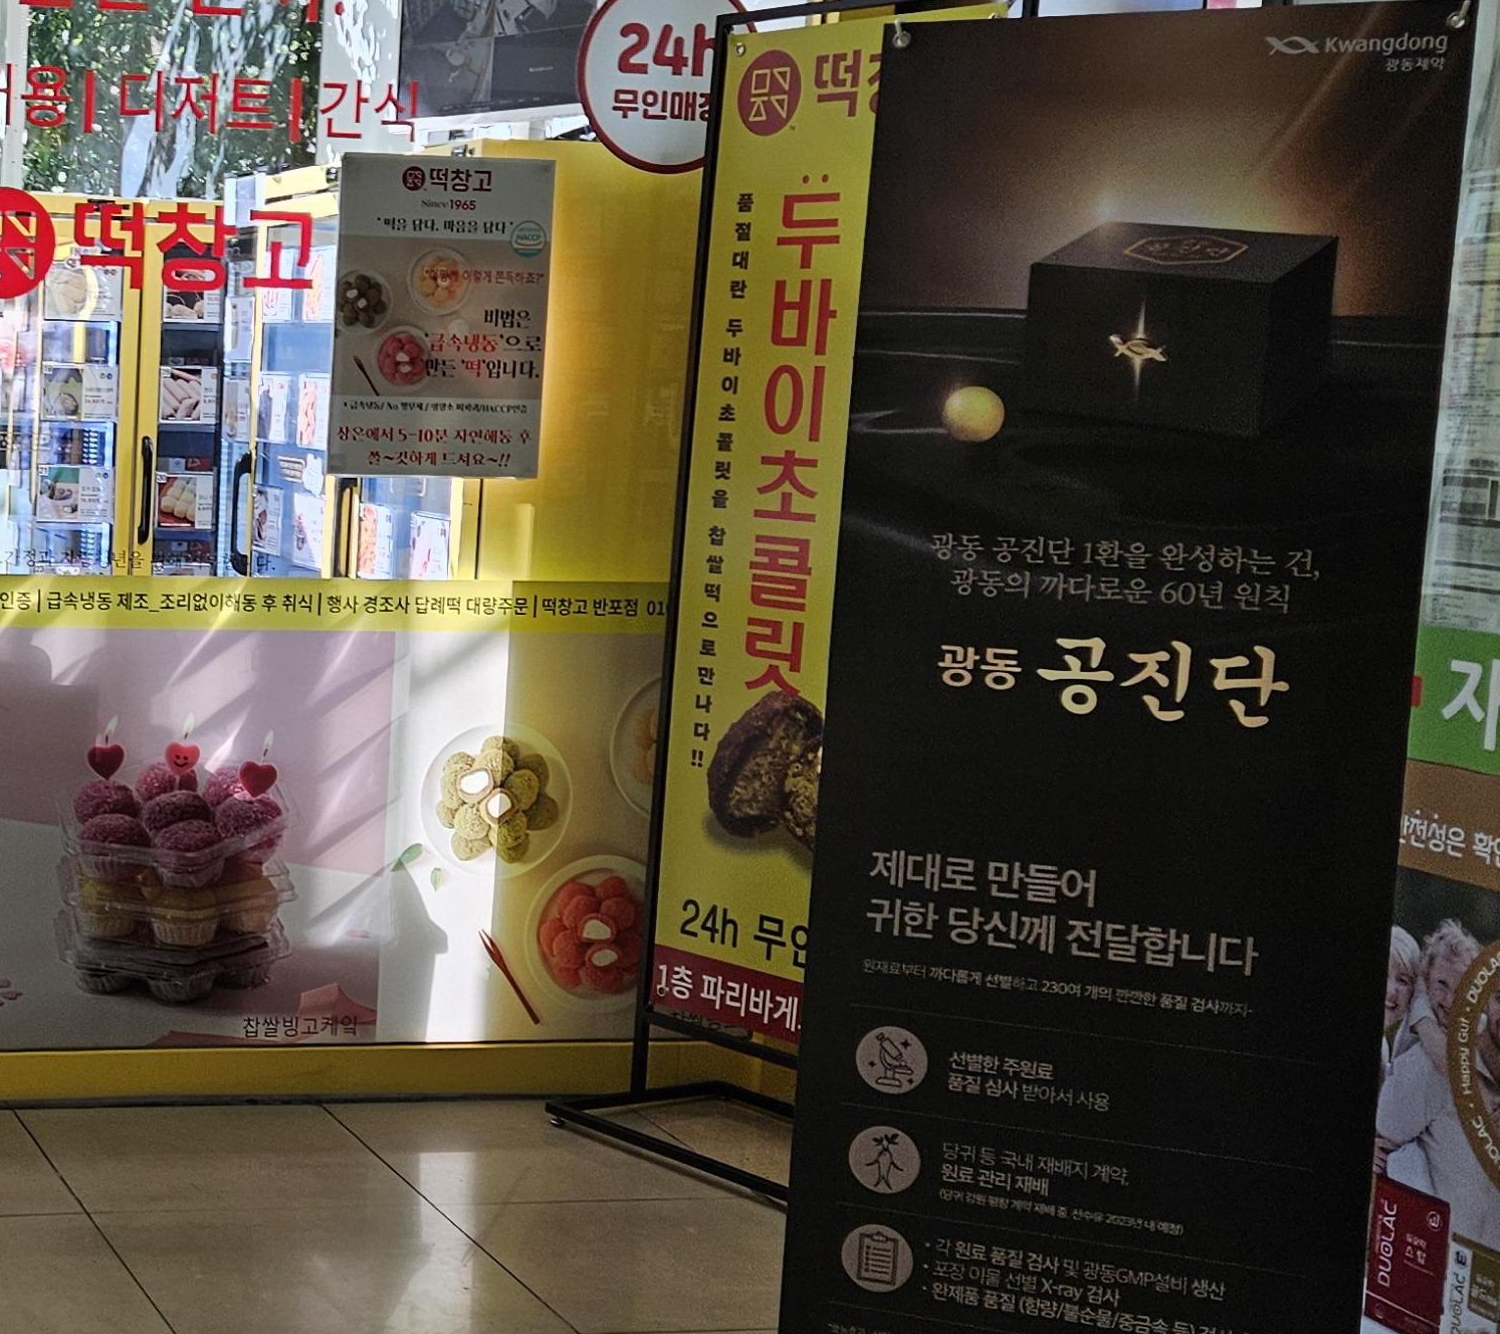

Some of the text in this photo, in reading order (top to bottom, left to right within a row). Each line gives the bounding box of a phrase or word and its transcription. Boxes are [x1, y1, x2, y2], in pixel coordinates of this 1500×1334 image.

[1323, 31, 1449, 55] Kwangdong
[1385, 56, 1447, 73] 광동제약
[117, 69, 276, 135] 디저트
[316, 77, 420, 141] 간식
[813, 49, 885, 118] 떡
[428, 167, 493, 193] 떡창고
[74, 200, 313, 292] 떡창고
[482, 308, 532, 331] 비법은
[710, 192, 755, 510] 품절대란 두바이초콜릿을
[930, 533, 985, 562] 광동
[992, 535, 1076, 566] 공진단
[1082, 540, 1153, 571] 1환을
[1158, 543, 1276, 575] 완성하는
[0, 590, 32, 612] 인증
[46, 590, 113, 612] 급속냉동
[260, 593, 277, 613] 후
[281, 593, 314, 614] 취식
[326, 595, 359, 615] 행사
[363, 595, 411, 616] 경조사
[415, 596, 462, 616] 답례떡
[466, 597, 530, 617] 대량주문
[542, 597, 589, 617] 떡창고
[592, 598, 640, 618] 반포점
[949, 568, 1291, 616] 광동의 까다로운 60년 원칙
[937, 636, 1291, 729] 광동 공진단
[868, 849, 1099, 909] 제대로 만들어
[679, 897, 739, 949] 24h
[865, 897, 1260, 978] 귀한 당신께 전달합니다
[655, 964, 802, 1033] 1층 파리바게
[1376, 1198, 1399, 1288] DUOLAC
